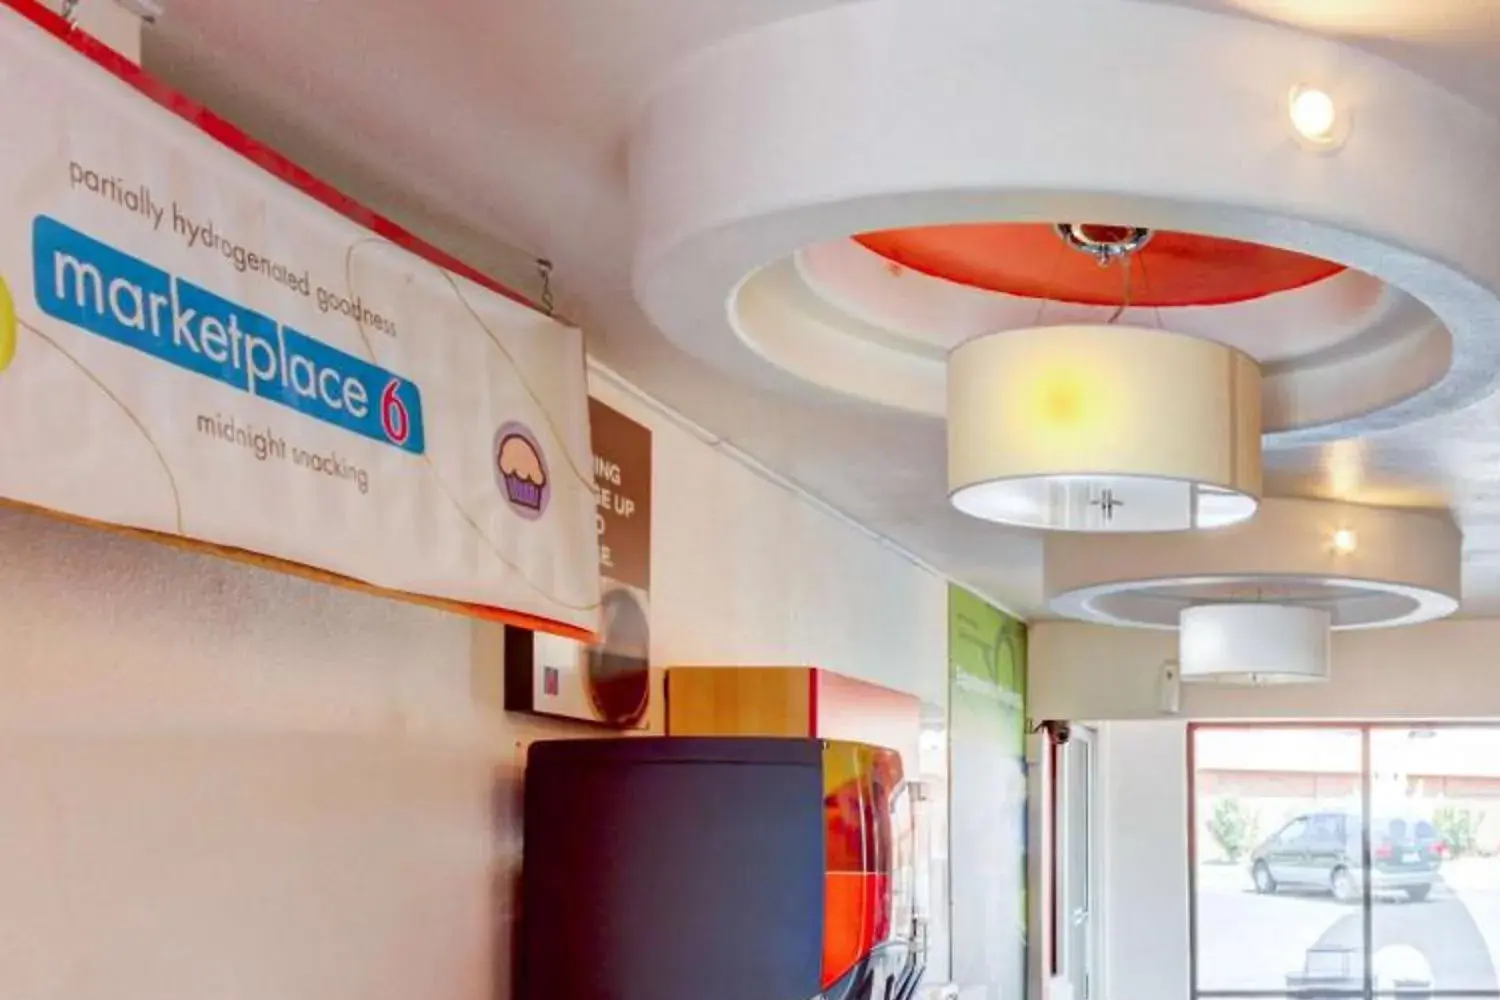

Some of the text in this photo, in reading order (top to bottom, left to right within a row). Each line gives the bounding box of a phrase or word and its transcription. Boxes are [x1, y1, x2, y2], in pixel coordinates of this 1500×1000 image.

[69, 160, 398, 338] partially hydrogenated goodness
[53, 251, 410, 444] marketplace 6
[197, 412, 369, 494] midnight snacking
[614, 494, 635, 518] UP
